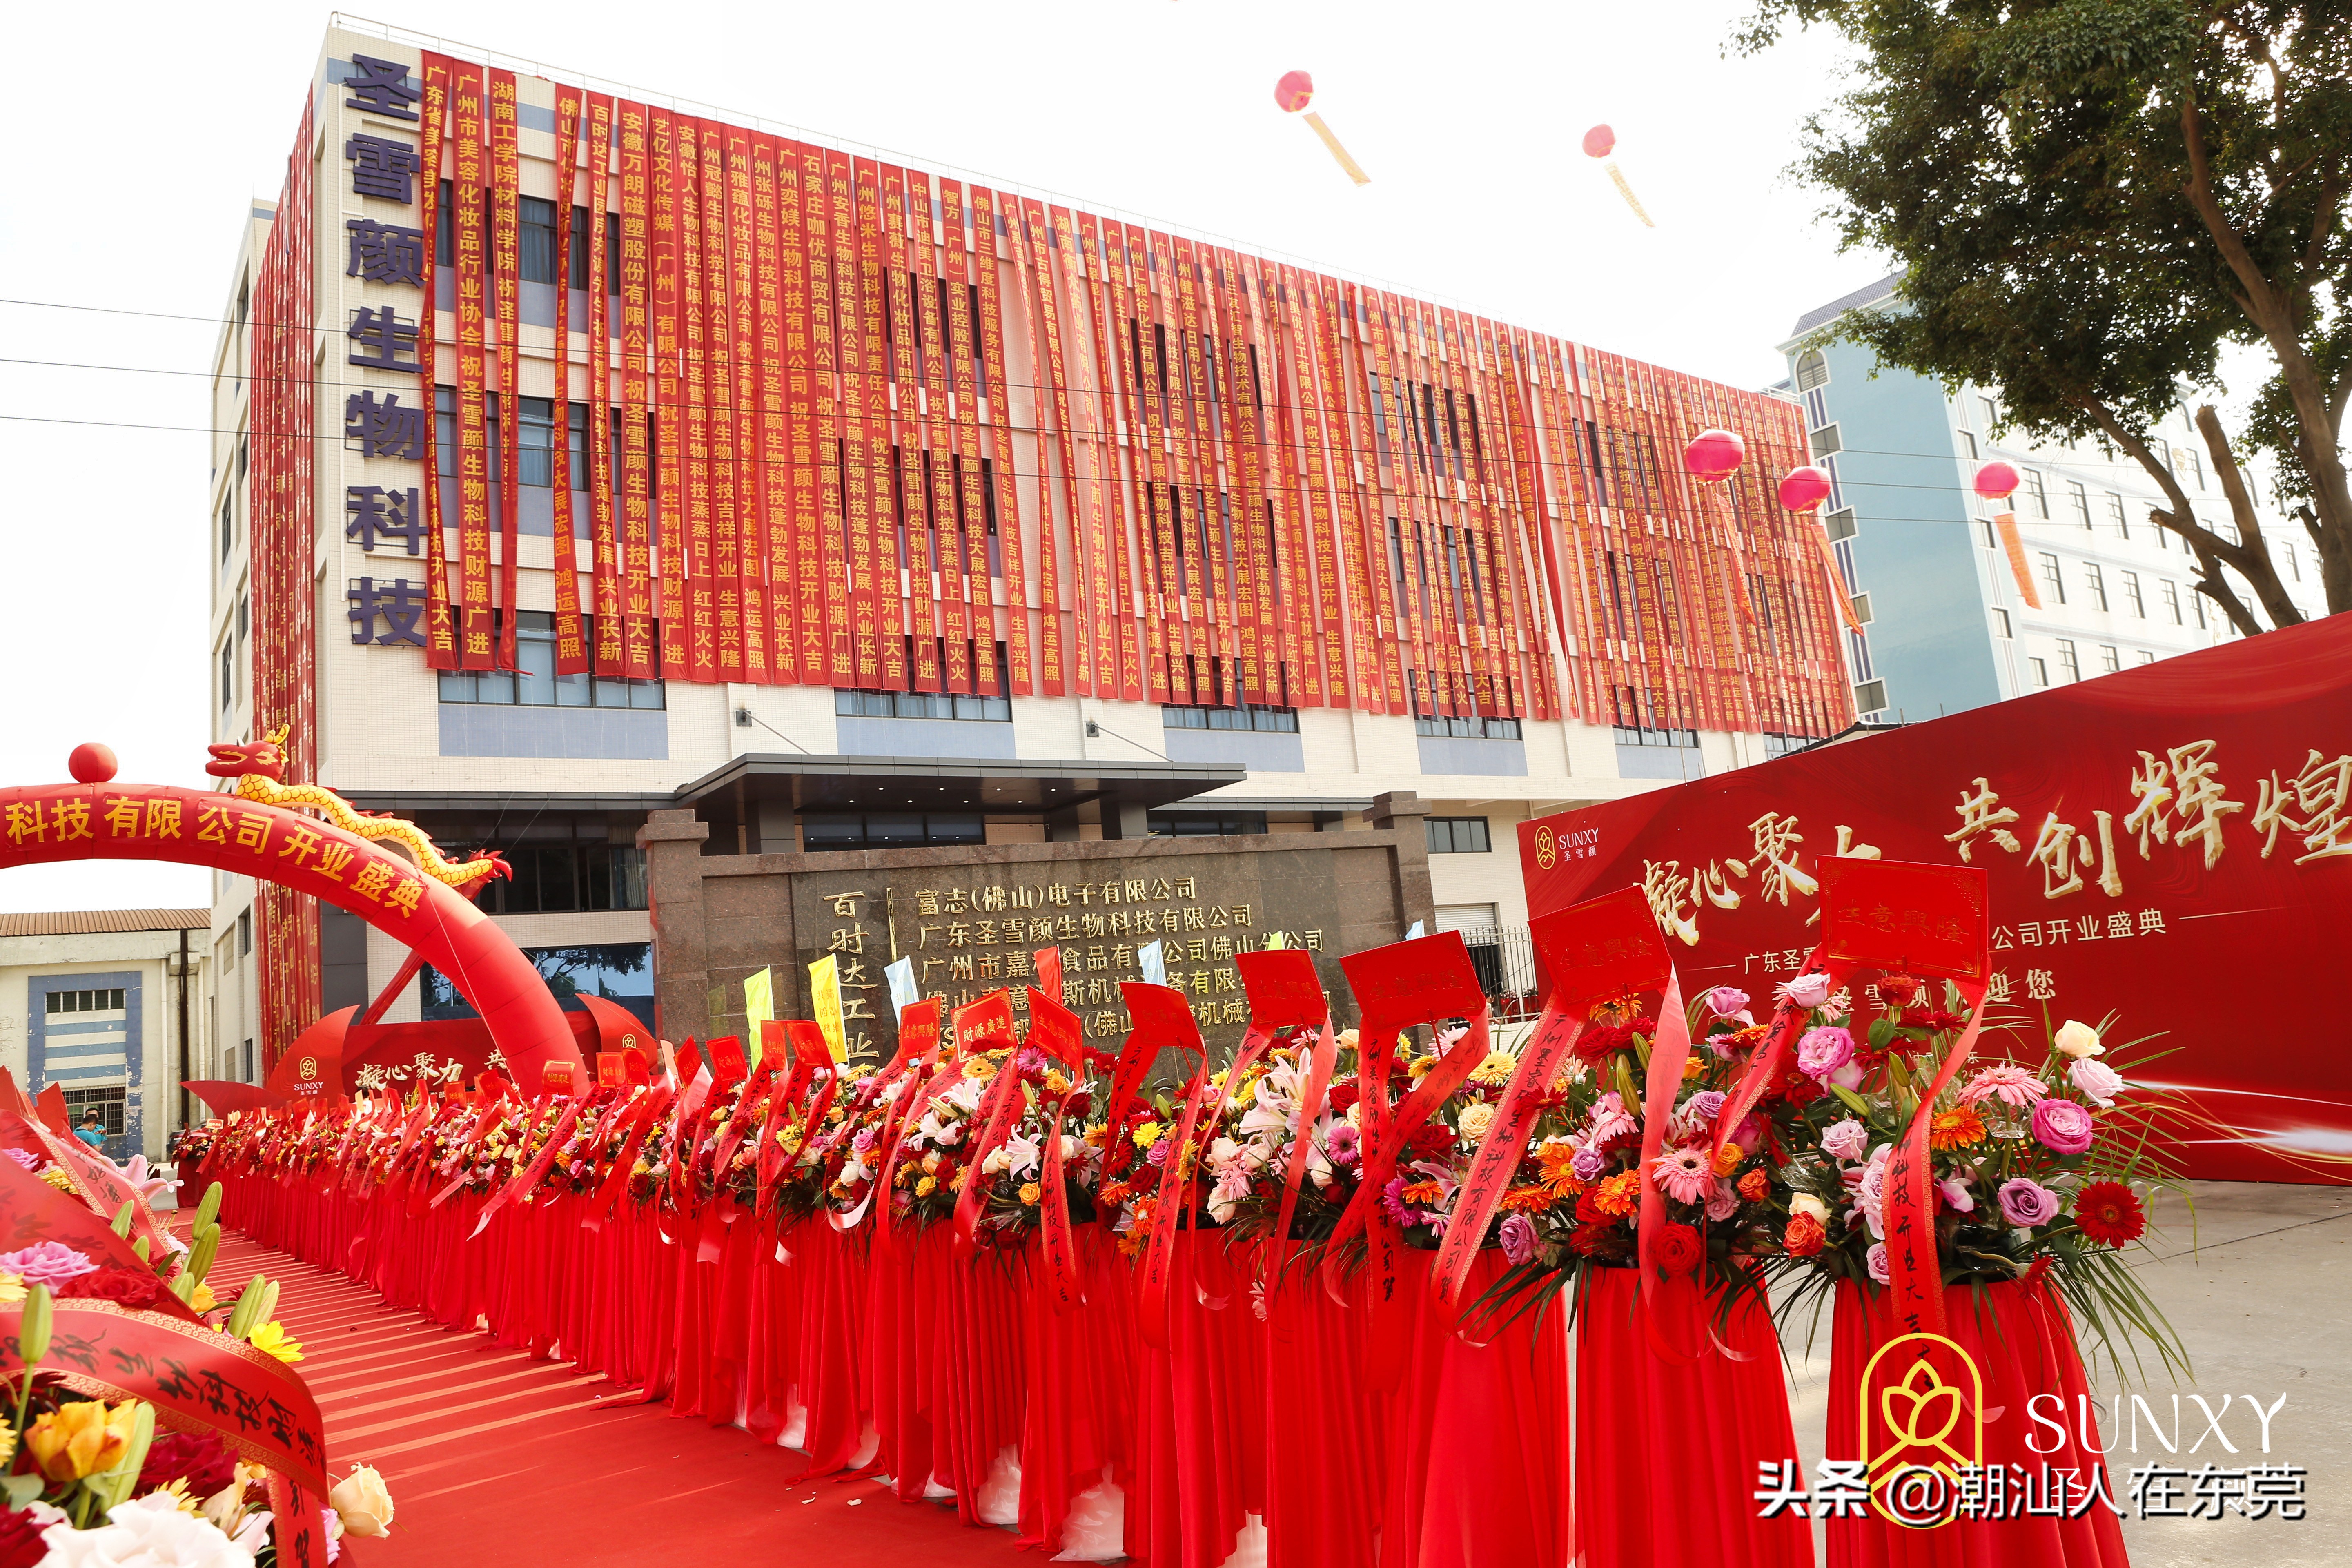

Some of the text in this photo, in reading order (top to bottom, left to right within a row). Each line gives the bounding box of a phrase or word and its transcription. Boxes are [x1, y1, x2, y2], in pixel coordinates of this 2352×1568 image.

[492, 80, 516, 272] 湖南工学院材料学院
[344, 53, 428, 647] 圣雪颜生物科技
[457, 72, 490, 655] 广州市美容化妆品行业协会 祝圣雪颜生物科技财源广进
[622, 110, 650, 664] 安徽万朗磁塑股份有限公司 祝圣雪颜生物科技开业大吉
[677, 125, 714, 668] 安徽怡人生物科技有限公司 祝圣雪颜生物科技蒸蒸日上 红红火火
[728, 135, 753, 336] 广州雅蕴化妆品有限公司
[744, 588, 766, 668] 鸿运高照
[804, 154, 851, 674] 石家庄咖优商贸有限公司 祝圣雪颜生物科技财源广进
[830, 160, 878, 675] 广州安香生物科技有限公司 祝圣雪颜生物科技蓬勃发展 兴业长新
[856, 167, 903, 677] 广州悠米生物科技有限责任公司 祝圣雪颜生物科技开业大吉
[884, 174, 935, 679] 广州赛薇生物化妆品有限公司 祝圣雪颜生物科技财源广进
[912, 181, 967, 681] 中山市迪美卫浴设备有限公司 祝圣雪颜生物科技蒸蒸日上 红红火火
[974, 195, 1029, 682] 佛山市三维度科技服务有限公司 祝圣雪颜生物科技吉祥开业 生意兴隆
[1175, 245, 1213, 468] 广州健滋达日用化工有限公司
[659, 402, 685, 664] 祝圣雪颜生物科技财源广进
[711, 348, 737, 579] 祝圣雪颜生物科技吉祥开业
[762, 357, 790, 584] 祝圣雪颜生物科技蓬勃发展
[790, 400, 824, 671] 祝圣雪颜生物科技开业大吉
[958, 409, 989, 607] 祝圣雪颜生物科技大展宏图
[974, 615, 995, 682] 鸿运高照
[1129, 234, 1187, 692] 广州汇湘谷化工有限公司 祝圣雪颜生物科技吉祥开业 生意兴隆
[1172, 425, 1204, 618] 祝圣雪颜生物科技大展宏图
[1192, 626, 1211, 691] 鸿运高照
[1222, 428, 1259, 691] 祝圣雪颜生物科技大展宏图 鸿运高照
[1223, 256, 1278, 693] 北京三友汇智生物技术有限公司 祝圣雪颜生物科技蓬勃发展 兴业长新
[1267, 437, 1296, 623] 祝圣雪颜生物科技蒸蒸日上
[1284, 632, 1301, 695] 红红火火
[1304, 424, 1345, 696] 祝圣雪颜生物科技吉祥开业 生意兴隆
[1328, 427, 1364, 622] 祝圣雪颜生物科技吉祥开业
[1352, 631, 1370, 698] 生意兴隆
[1365, 294, 1430, 703] 广州市奥源贸易有限公司 祝圣雪颜生物科技开业大吉
[1443, 315, 1507, 707] 广州市天隅生物科技有限公司 祝圣雪颜生物科技开业大吉
[554, 571, 582, 659] 鸿运高照
[598, 577, 621, 661] 兴业长新
[718, 588, 740, 668] 生意兴隆
[772, 595, 795, 670] 兴业长新
[1042, 612, 1060, 681] 鸿运高照
[1121, 622, 1139, 687] 红红火火
[1363, 451, 1402, 703] 祝圣雪颜生物科技大展宏图 鸿运高照
[1432, 641, 1450, 704] 兴业长新
[1448, 643, 1468, 705] 红红火火
[1452, 512, 1492, 705] 祝圣雪颜生物科技开业大吉
[1488, 501, 1525, 707] 祝圣雪颜生物科技财源广进
[1572, 489, 1606, 652] 祝圣雪颜生物科技蒸蒸日上
[1598, 659, 1615, 714] 红红火火
[1607, 496, 1647, 717] 祝圣雪颜生物科技吉祥开业 生意兴隆
[1630, 542, 1668, 718] 祝圣雪颜生物科技开业大吉
[1657, 547, 1692, 719] 祝圣雪颜生物科技财源广进
[1581, 660, 1597, 714] 兴业长新
[1663, 666, 1679, 719] 生意兴隆
[1706, 673, 1721, 721] 红红火火
[1719, 675, 1735, 722] 兴业长新
[1730, 675, 1746, 722] 鸿运高照
[5, 795, 425, 919] 科技有限公司开业盛典
[915, 876, 1196, 916] 富志(佛山)电子有限公司
[1559, 827, 1599, 851] SUNXY
[1564, 846, 1597, 862] 圣雪颜
[1838, 899, 1970, 946] 生意興隆
[1944, 739, 2352, 900] 共创辉煌
[920, 903, 1252, 950] 广东圣雪颜生物科技有限公司
[962, 1015, 1007, 1043] 財源廣進
[1560, 933, 1652, 972] 生意興隆
[294, 1081, 323, 1091] SUNXY
[354, 1051, 464, 1091] 凝心聚力
